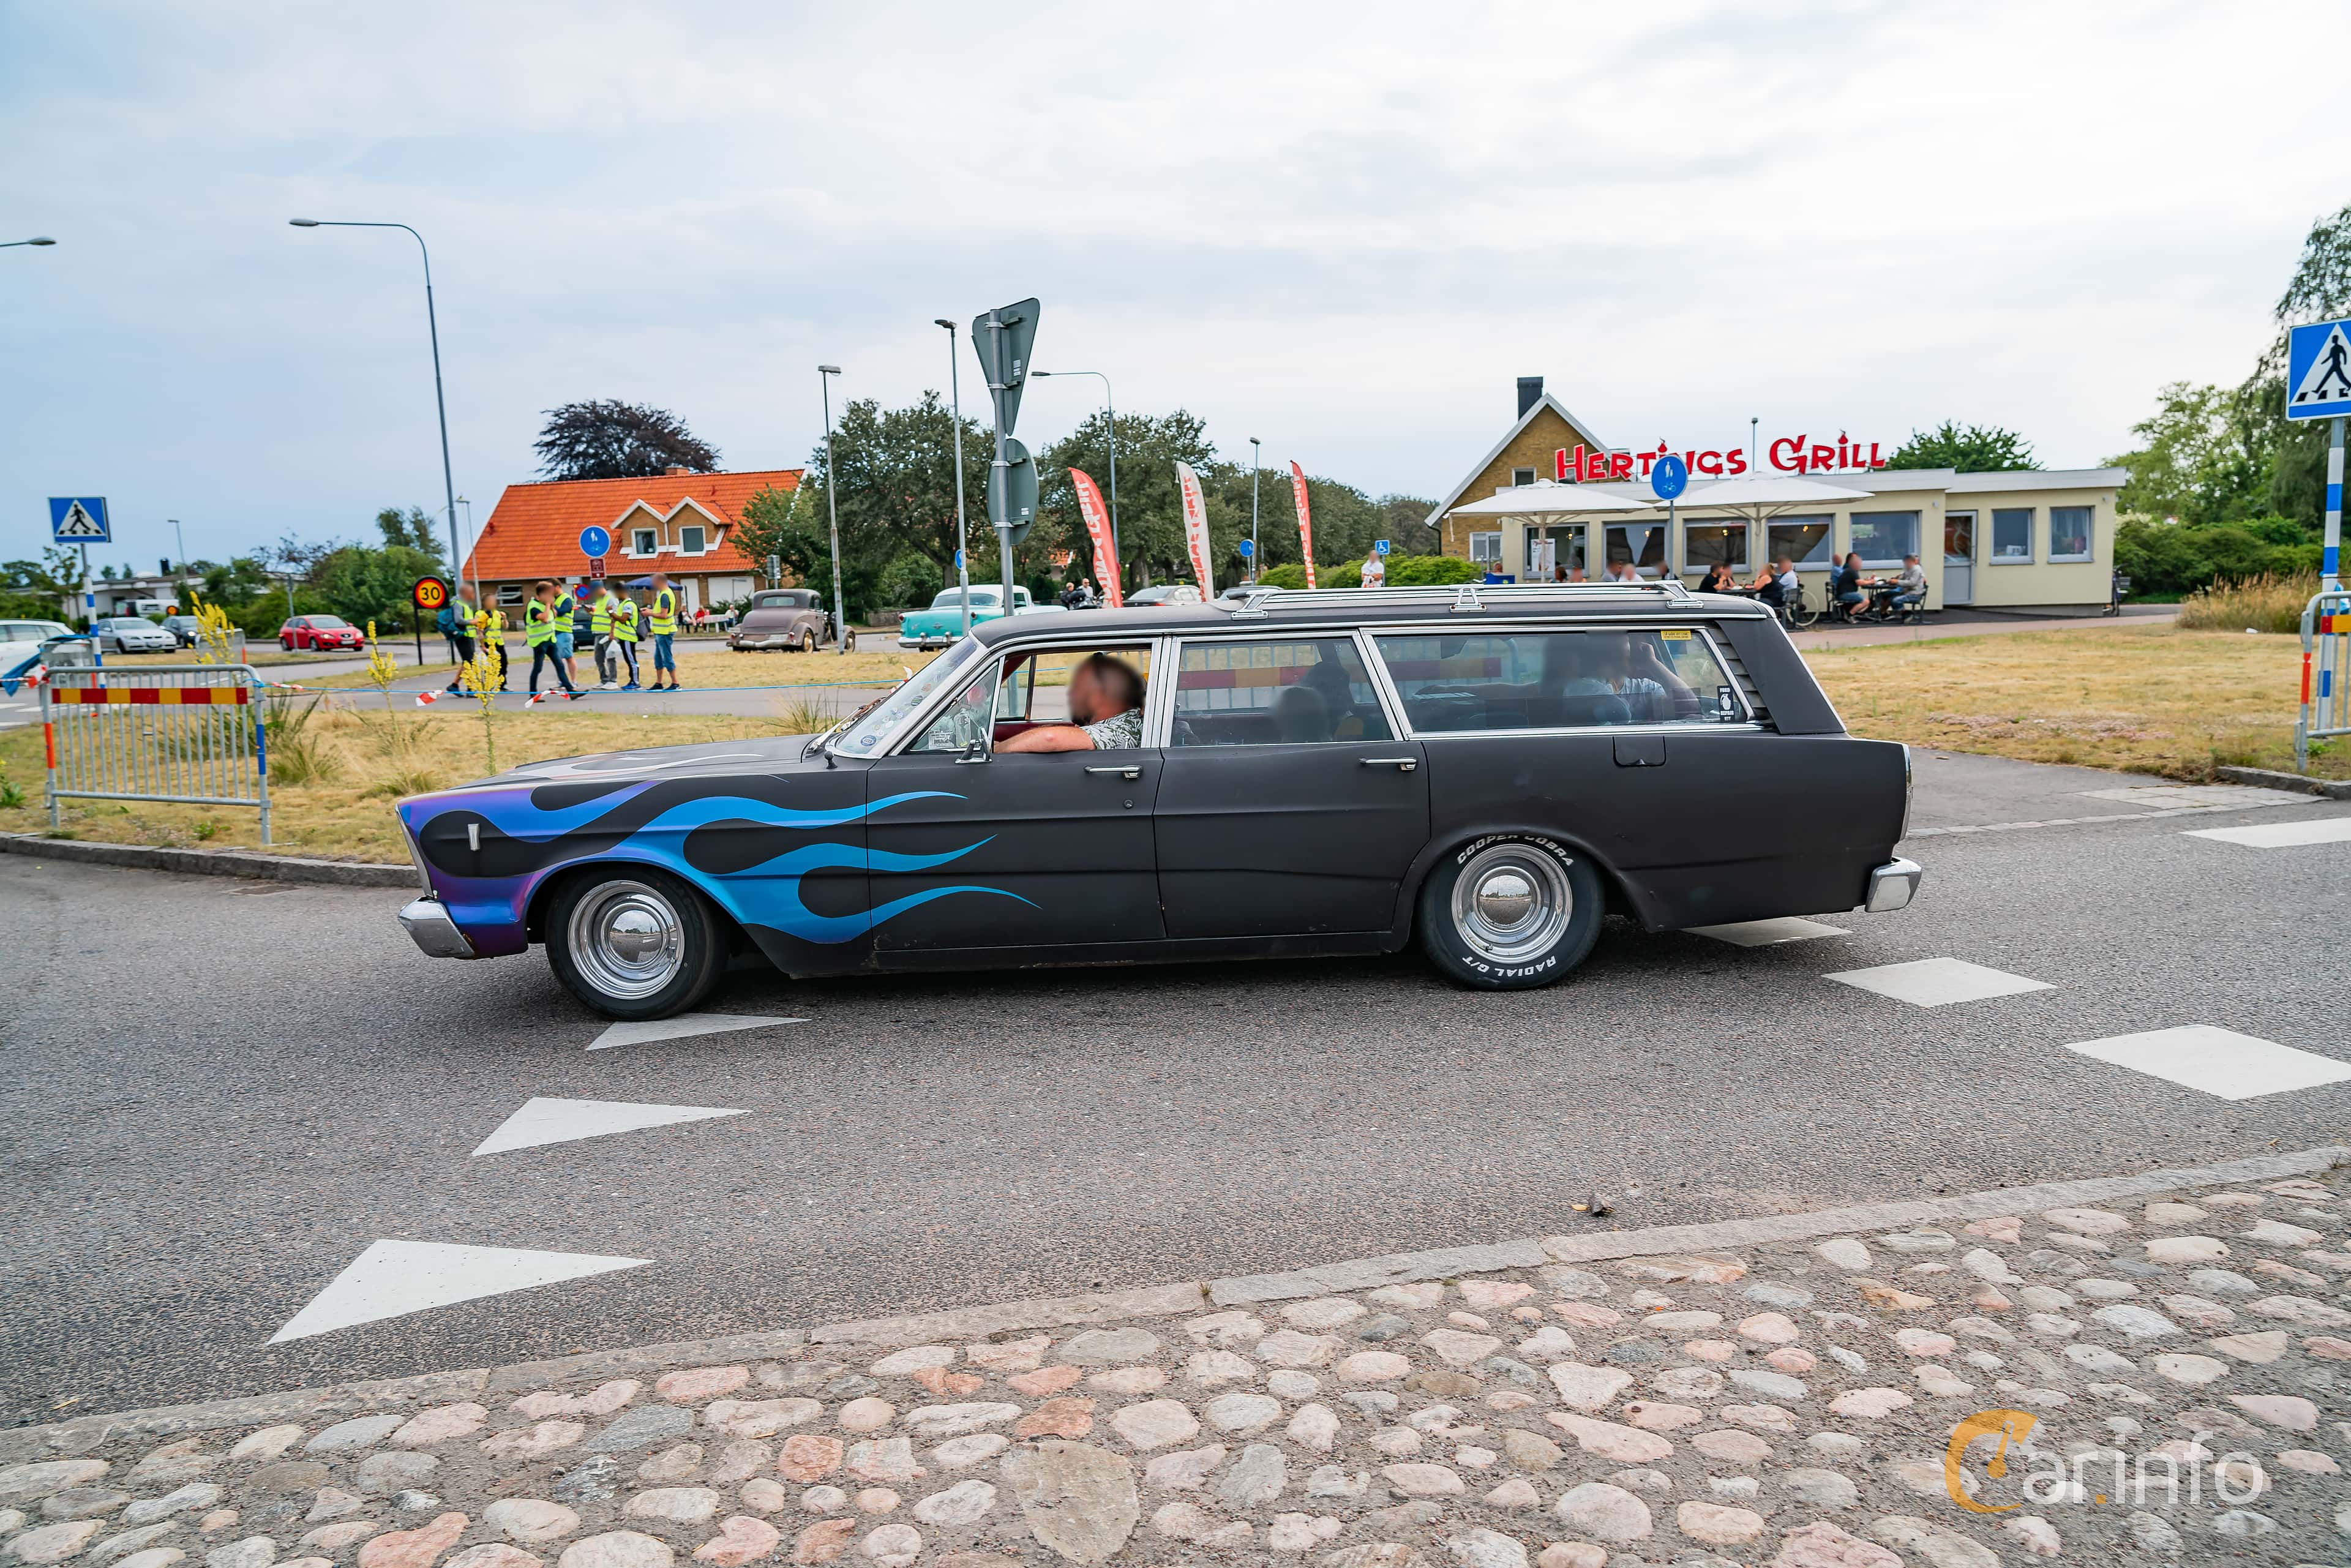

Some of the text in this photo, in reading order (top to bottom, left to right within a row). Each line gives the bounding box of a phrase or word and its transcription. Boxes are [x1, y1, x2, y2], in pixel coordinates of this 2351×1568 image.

[1769, 432, 1886, 475] GRILL
[421, 587, 440, 600] 30
[1524, 835, 1574, 866] COBRA
[1462, 955, 1556, 977] RADIAL G/T
